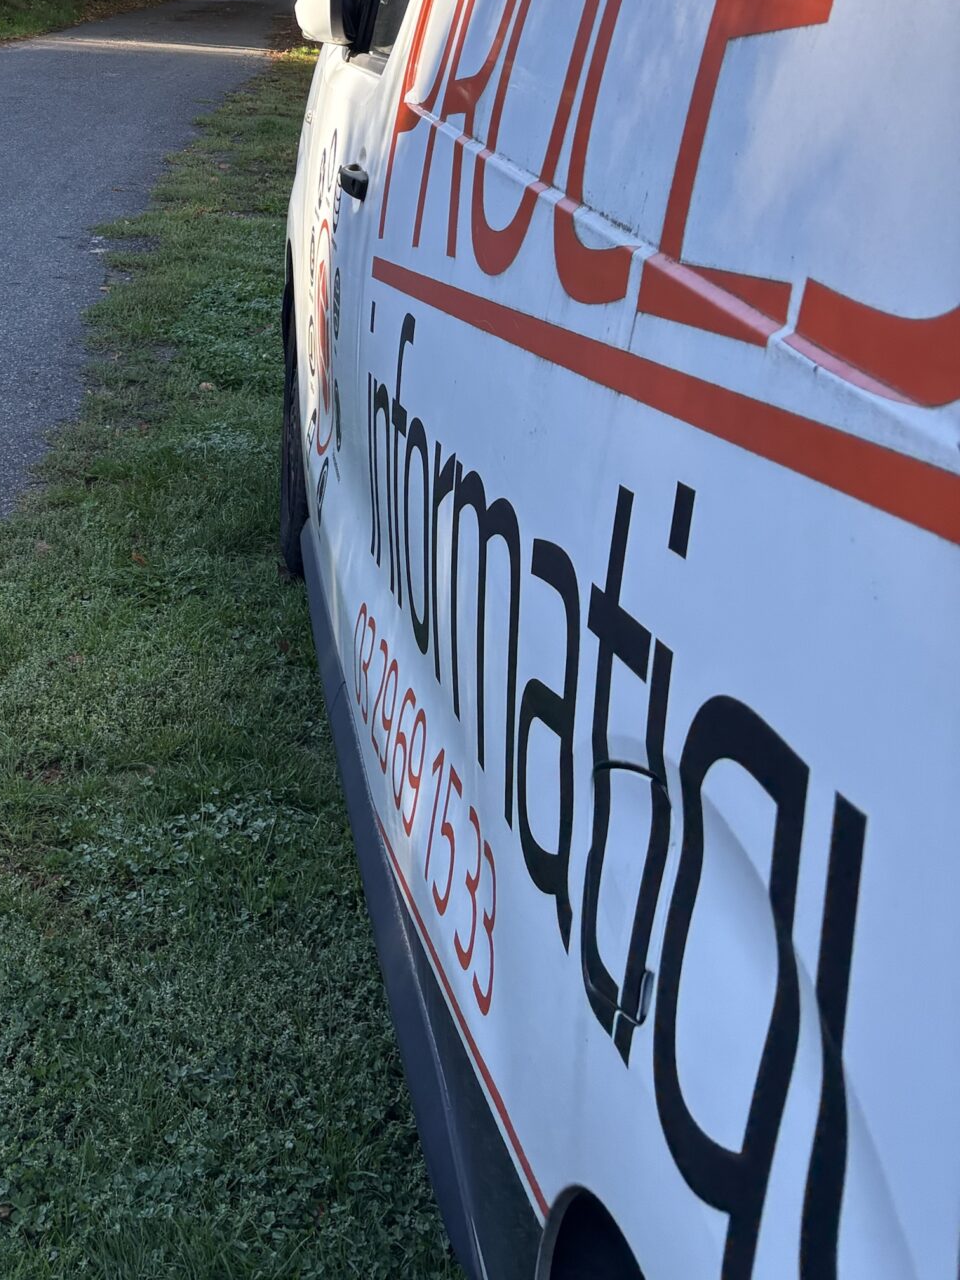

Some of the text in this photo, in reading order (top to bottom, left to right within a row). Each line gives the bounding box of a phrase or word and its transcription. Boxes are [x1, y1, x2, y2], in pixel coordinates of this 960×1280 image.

[353, 602, 498, 1017] 03 29 69 15 33
